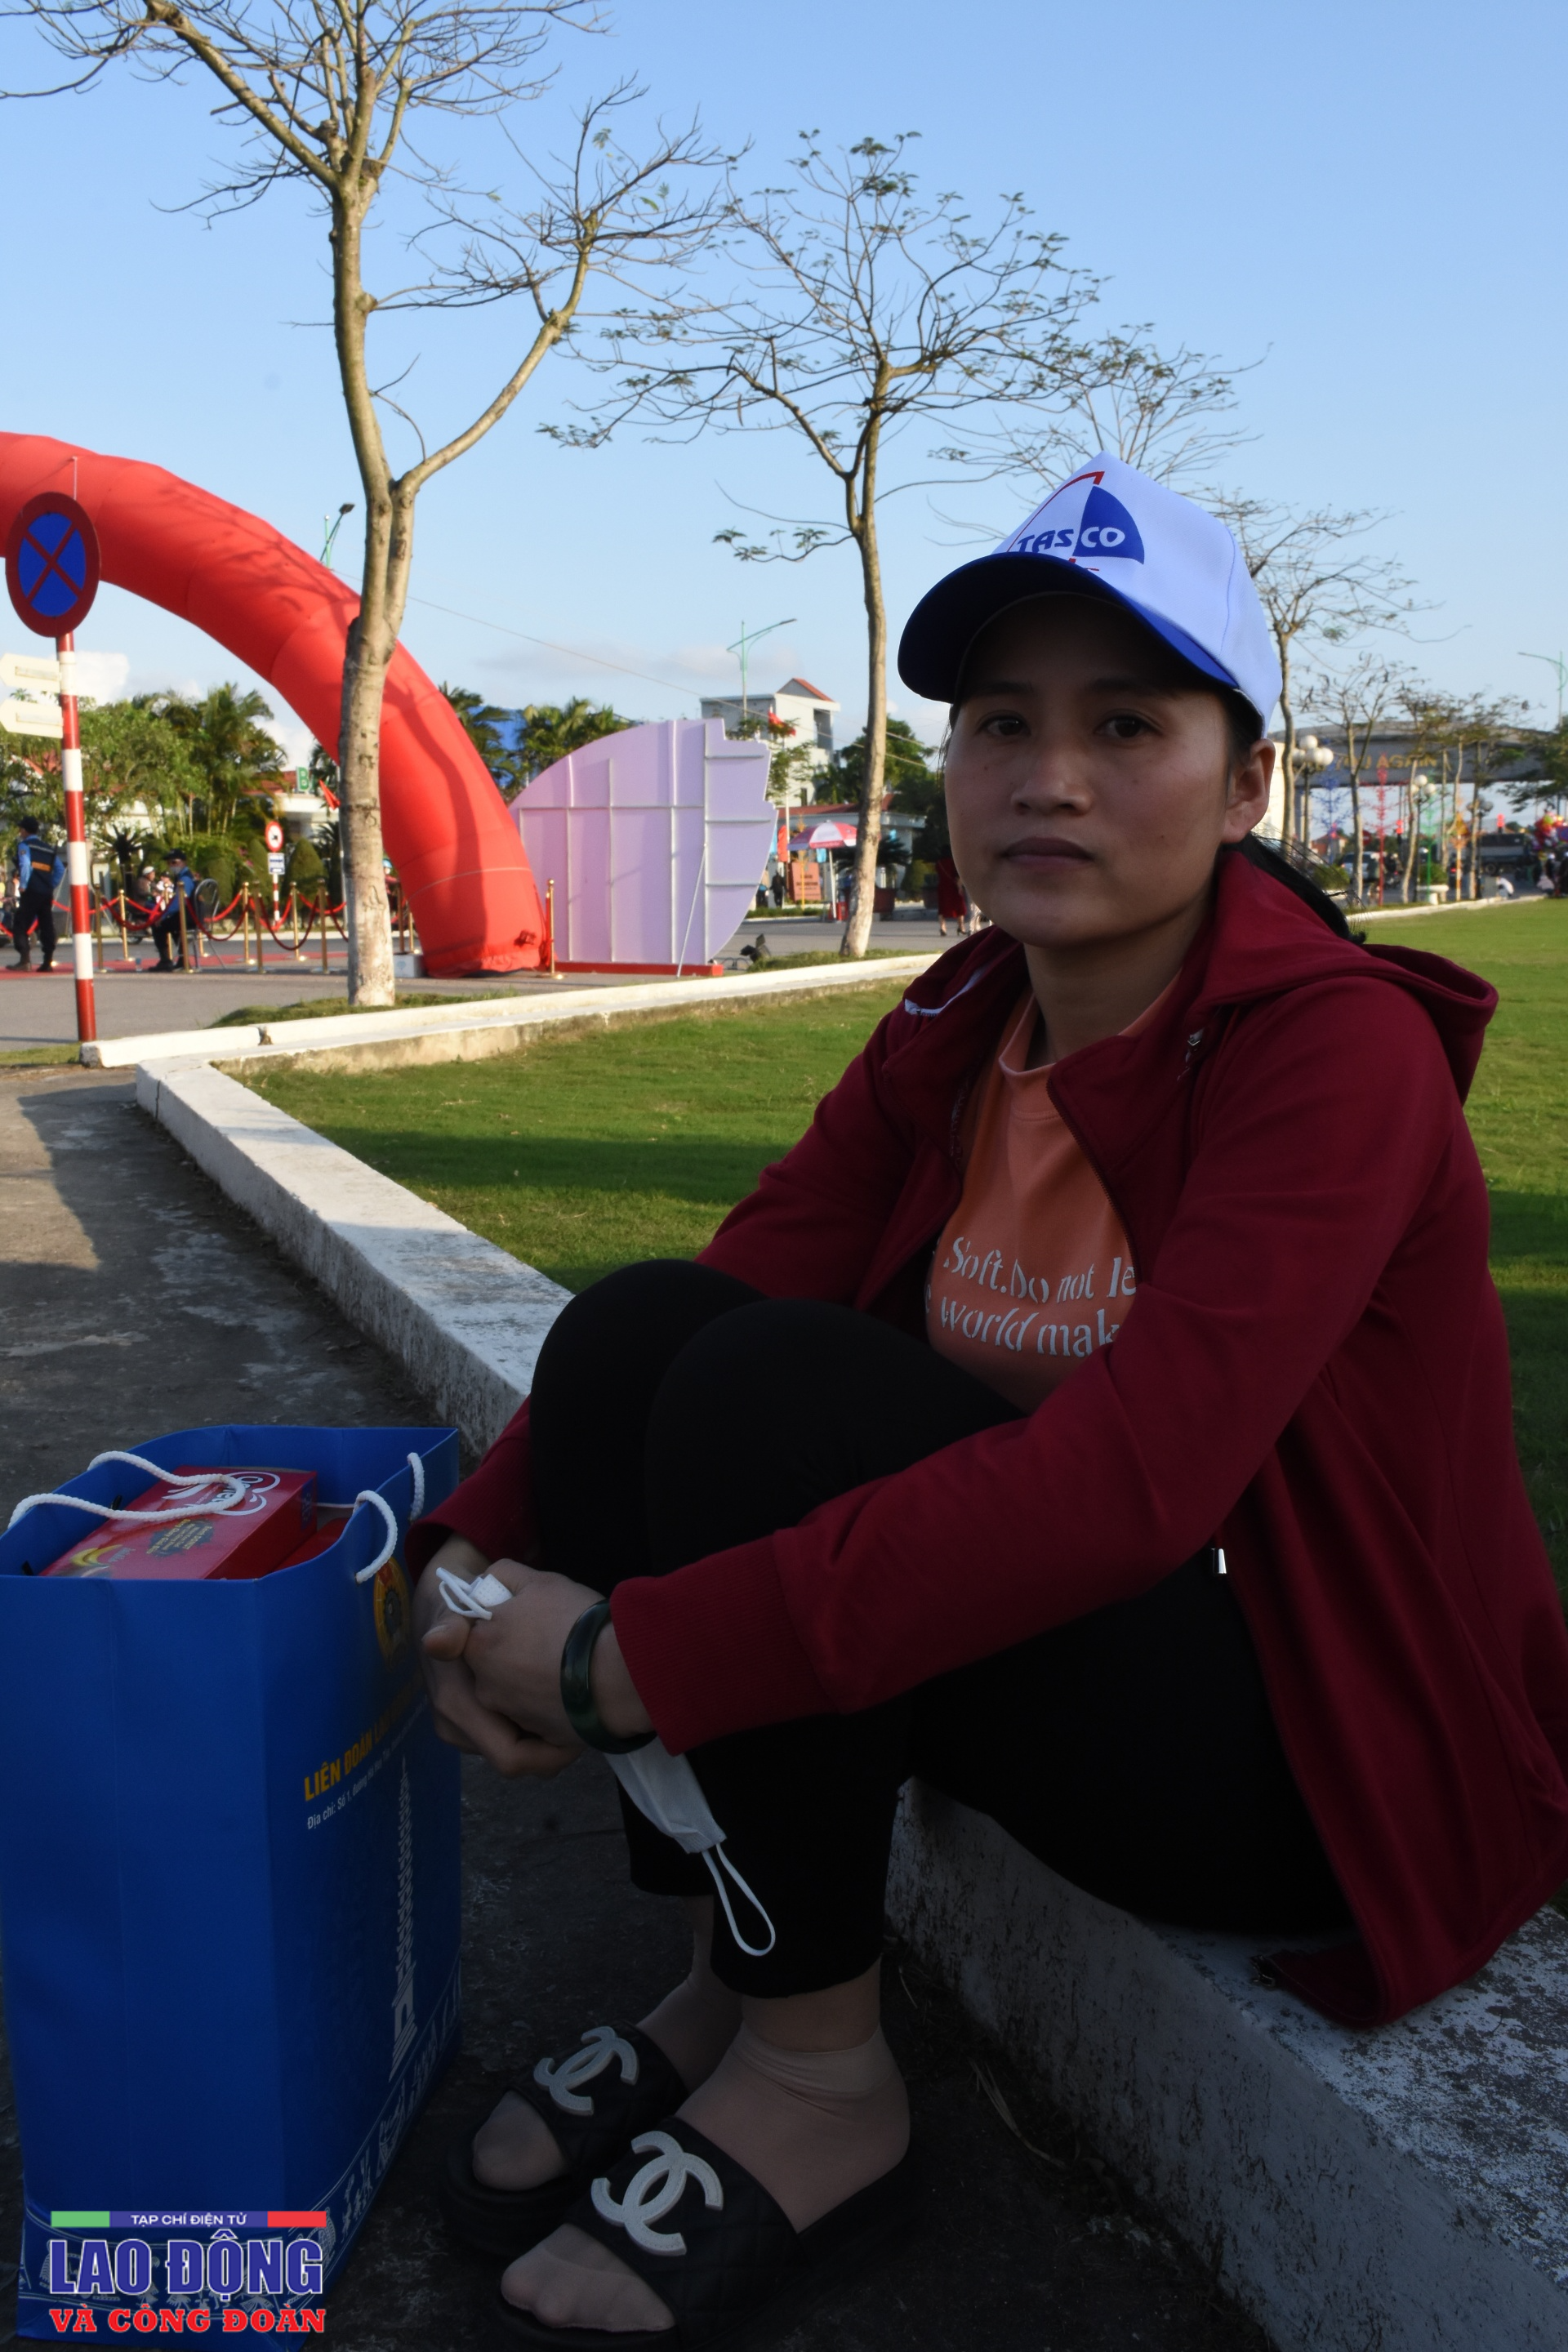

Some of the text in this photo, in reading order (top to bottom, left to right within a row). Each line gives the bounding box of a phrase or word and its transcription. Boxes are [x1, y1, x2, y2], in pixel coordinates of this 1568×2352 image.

[1017, 526, 1125, 553] TASCO
[1056, 1263, 1095, 1304] not
[940, 1295, 1040, 1352] world
[303, 1758, 341, 1802] LIÊN
[307, 1813, 321, 1830] Địa
